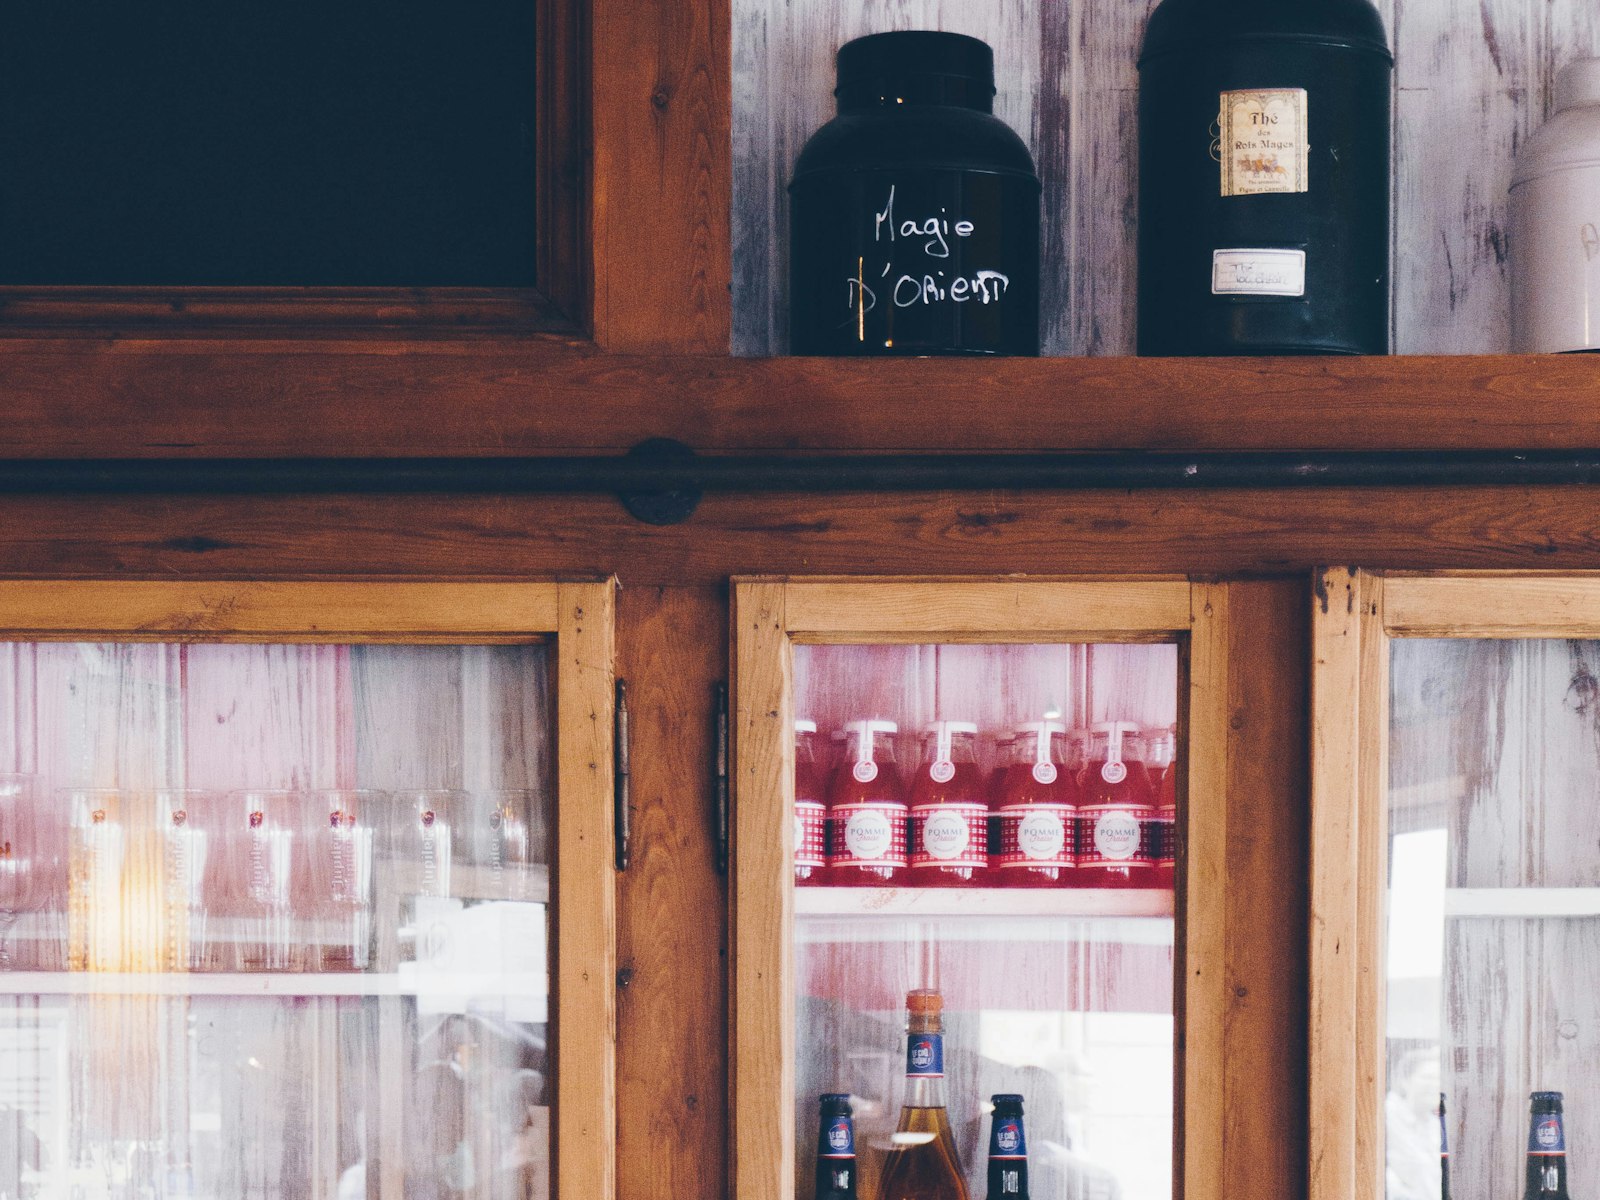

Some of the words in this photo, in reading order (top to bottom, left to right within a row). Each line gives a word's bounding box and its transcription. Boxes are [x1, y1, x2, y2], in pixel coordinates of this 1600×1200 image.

[1250, 112, 1278, 126] Thé
[1235, 140, 1257, 150] Rois
[1260, 140, 1294, 150] Mages
[875, 184, 975, 258] Magie
